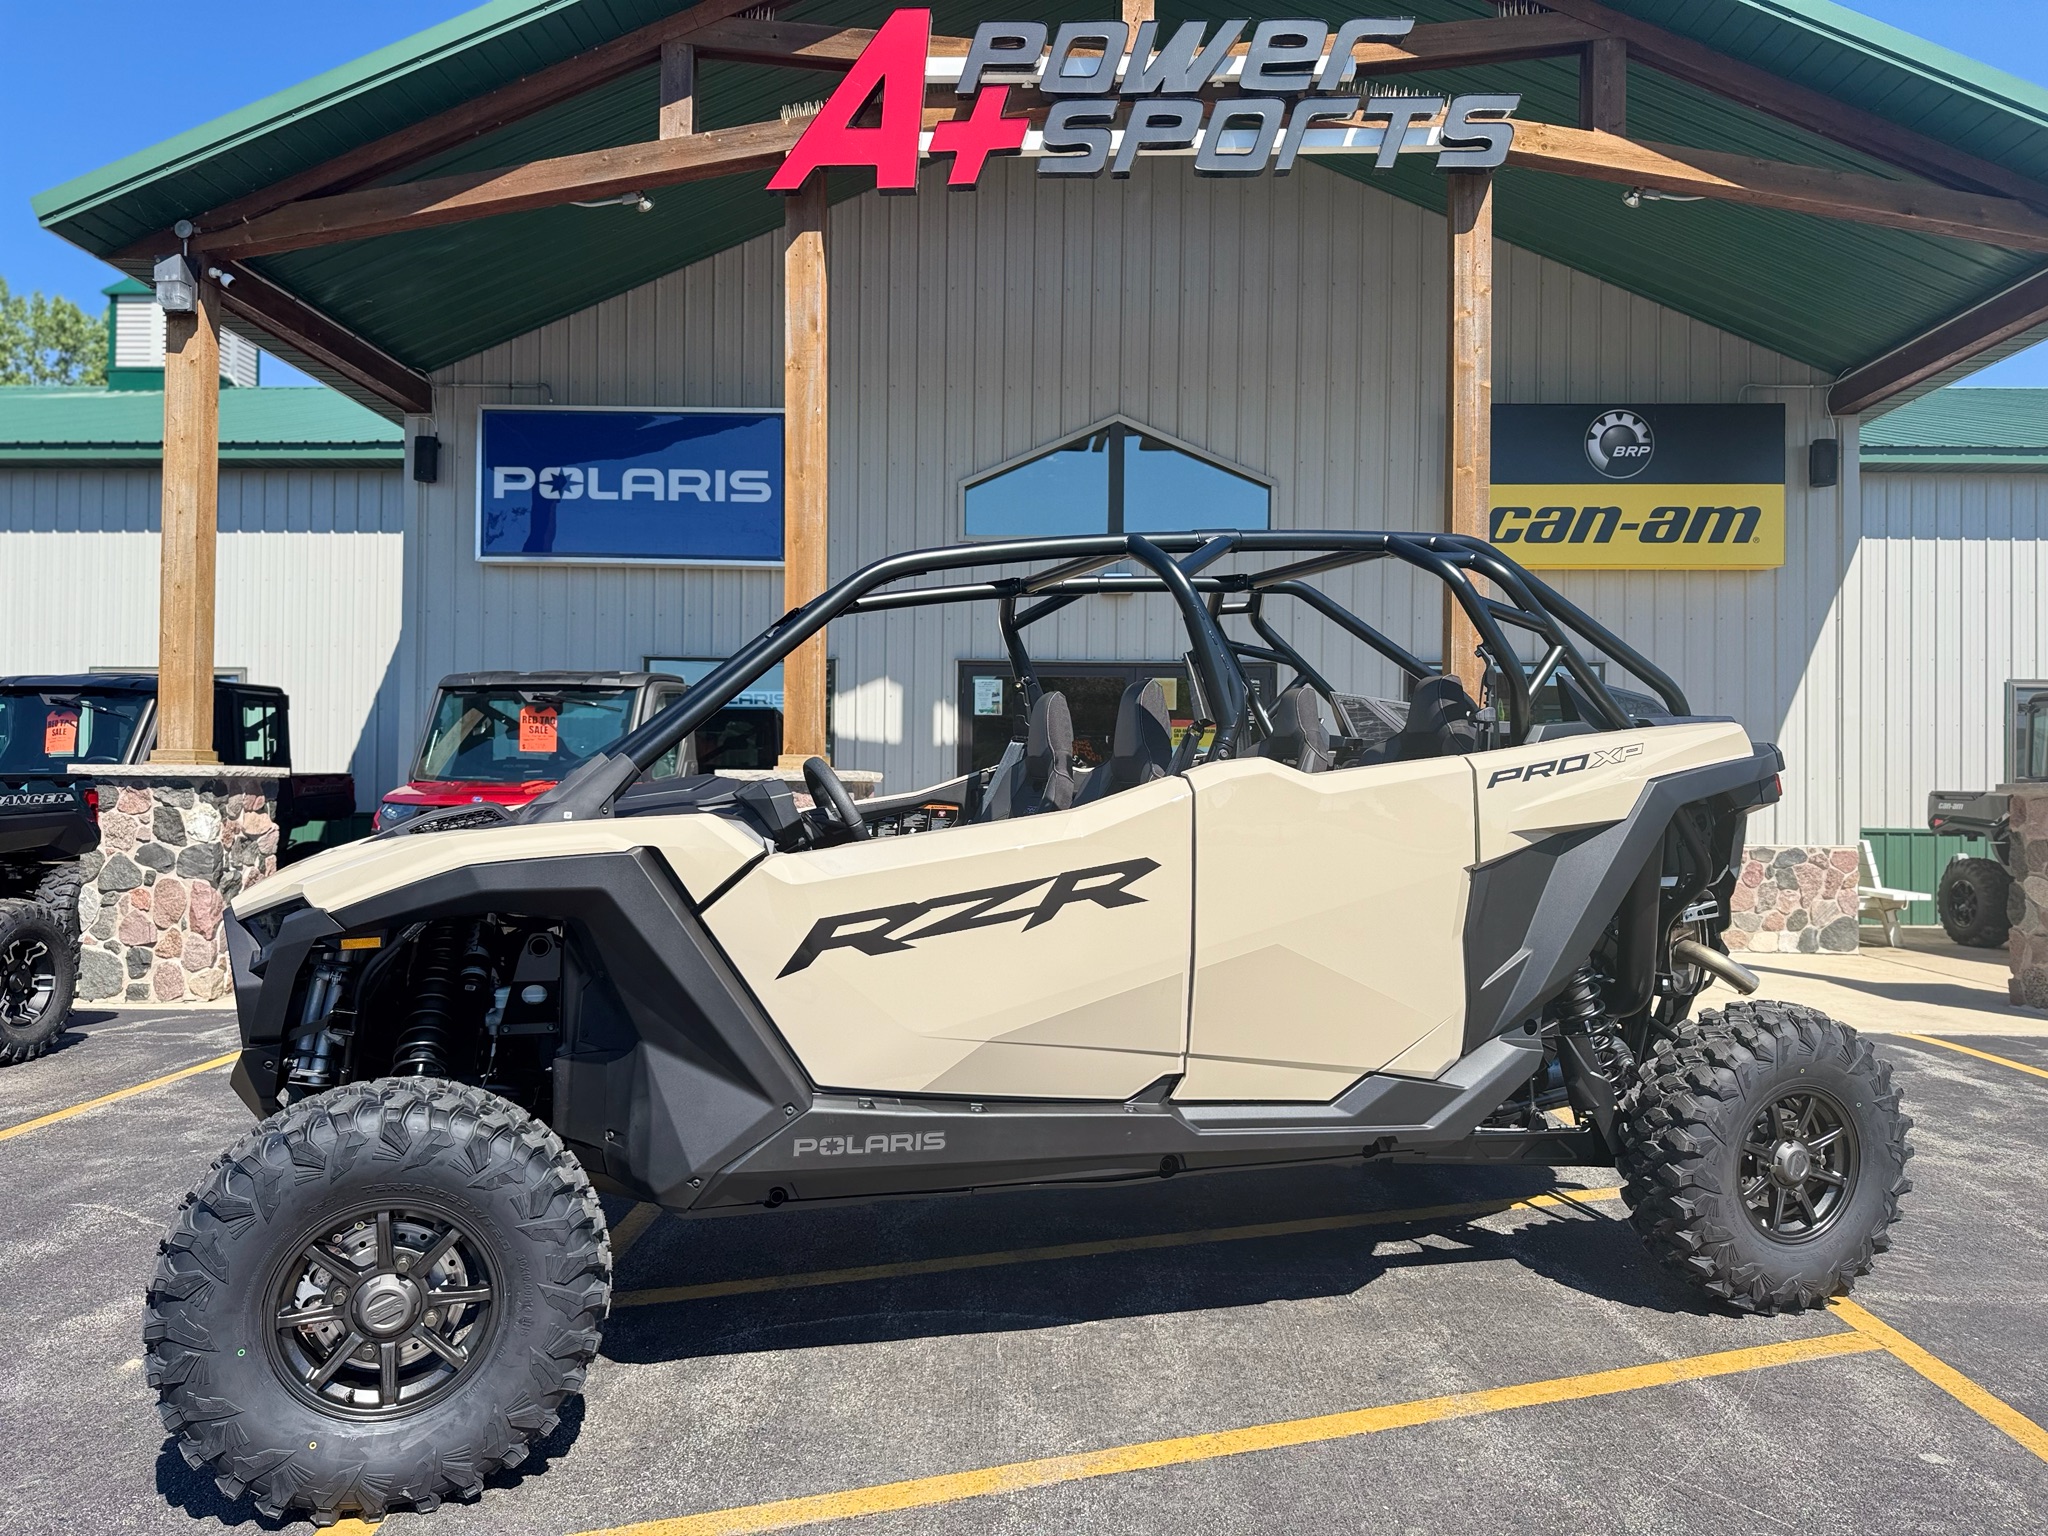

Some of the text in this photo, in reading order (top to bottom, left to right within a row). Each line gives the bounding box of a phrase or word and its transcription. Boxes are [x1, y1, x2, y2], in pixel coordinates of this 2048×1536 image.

[765, 7, 1031, 193] A+
[1612, 446, 1651, 457] BRP
[493, 466, 773, 503] POLARIS
[522, 716, 538, 724] RED
[52, 728, 67, 737] SALE
[529, 726, 549, 734] SALE
[0, 793, 68, 805] ANGER
[774, 856, 1163, 981] RZR
[793, 1132, 946, 1157] POLARIS
